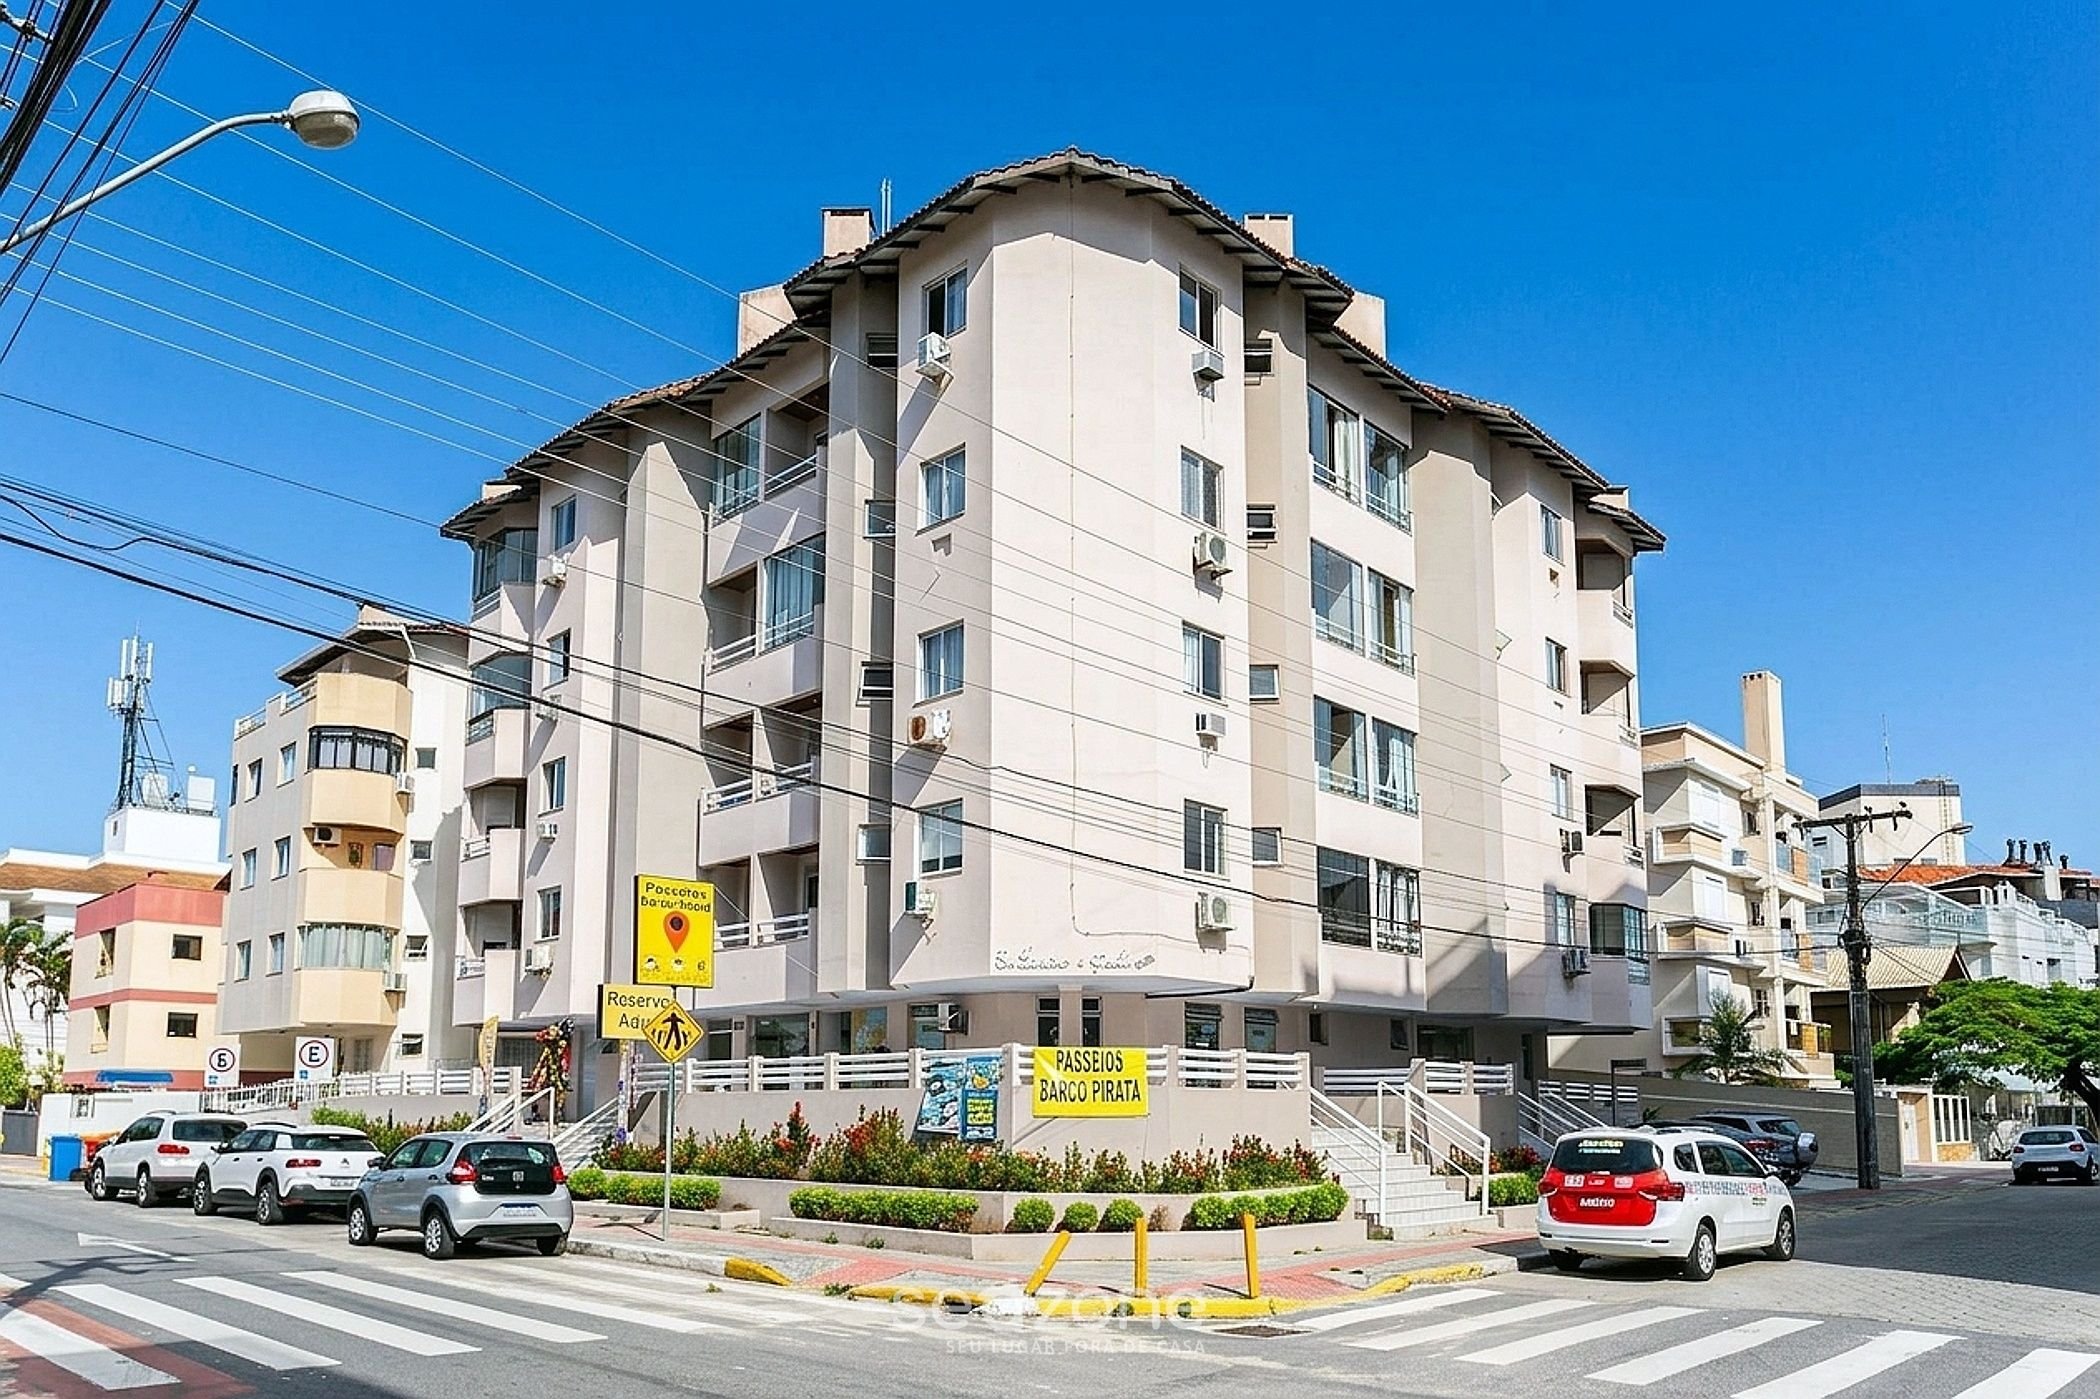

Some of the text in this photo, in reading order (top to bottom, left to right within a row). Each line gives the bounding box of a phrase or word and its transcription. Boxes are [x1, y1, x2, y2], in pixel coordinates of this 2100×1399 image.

[308, 1046, 320, 1063] E
[1055, 1049, 1124, 1073] PASSEIOS
[1039, 1079, 1142, 1103] BARCO PIRATA
